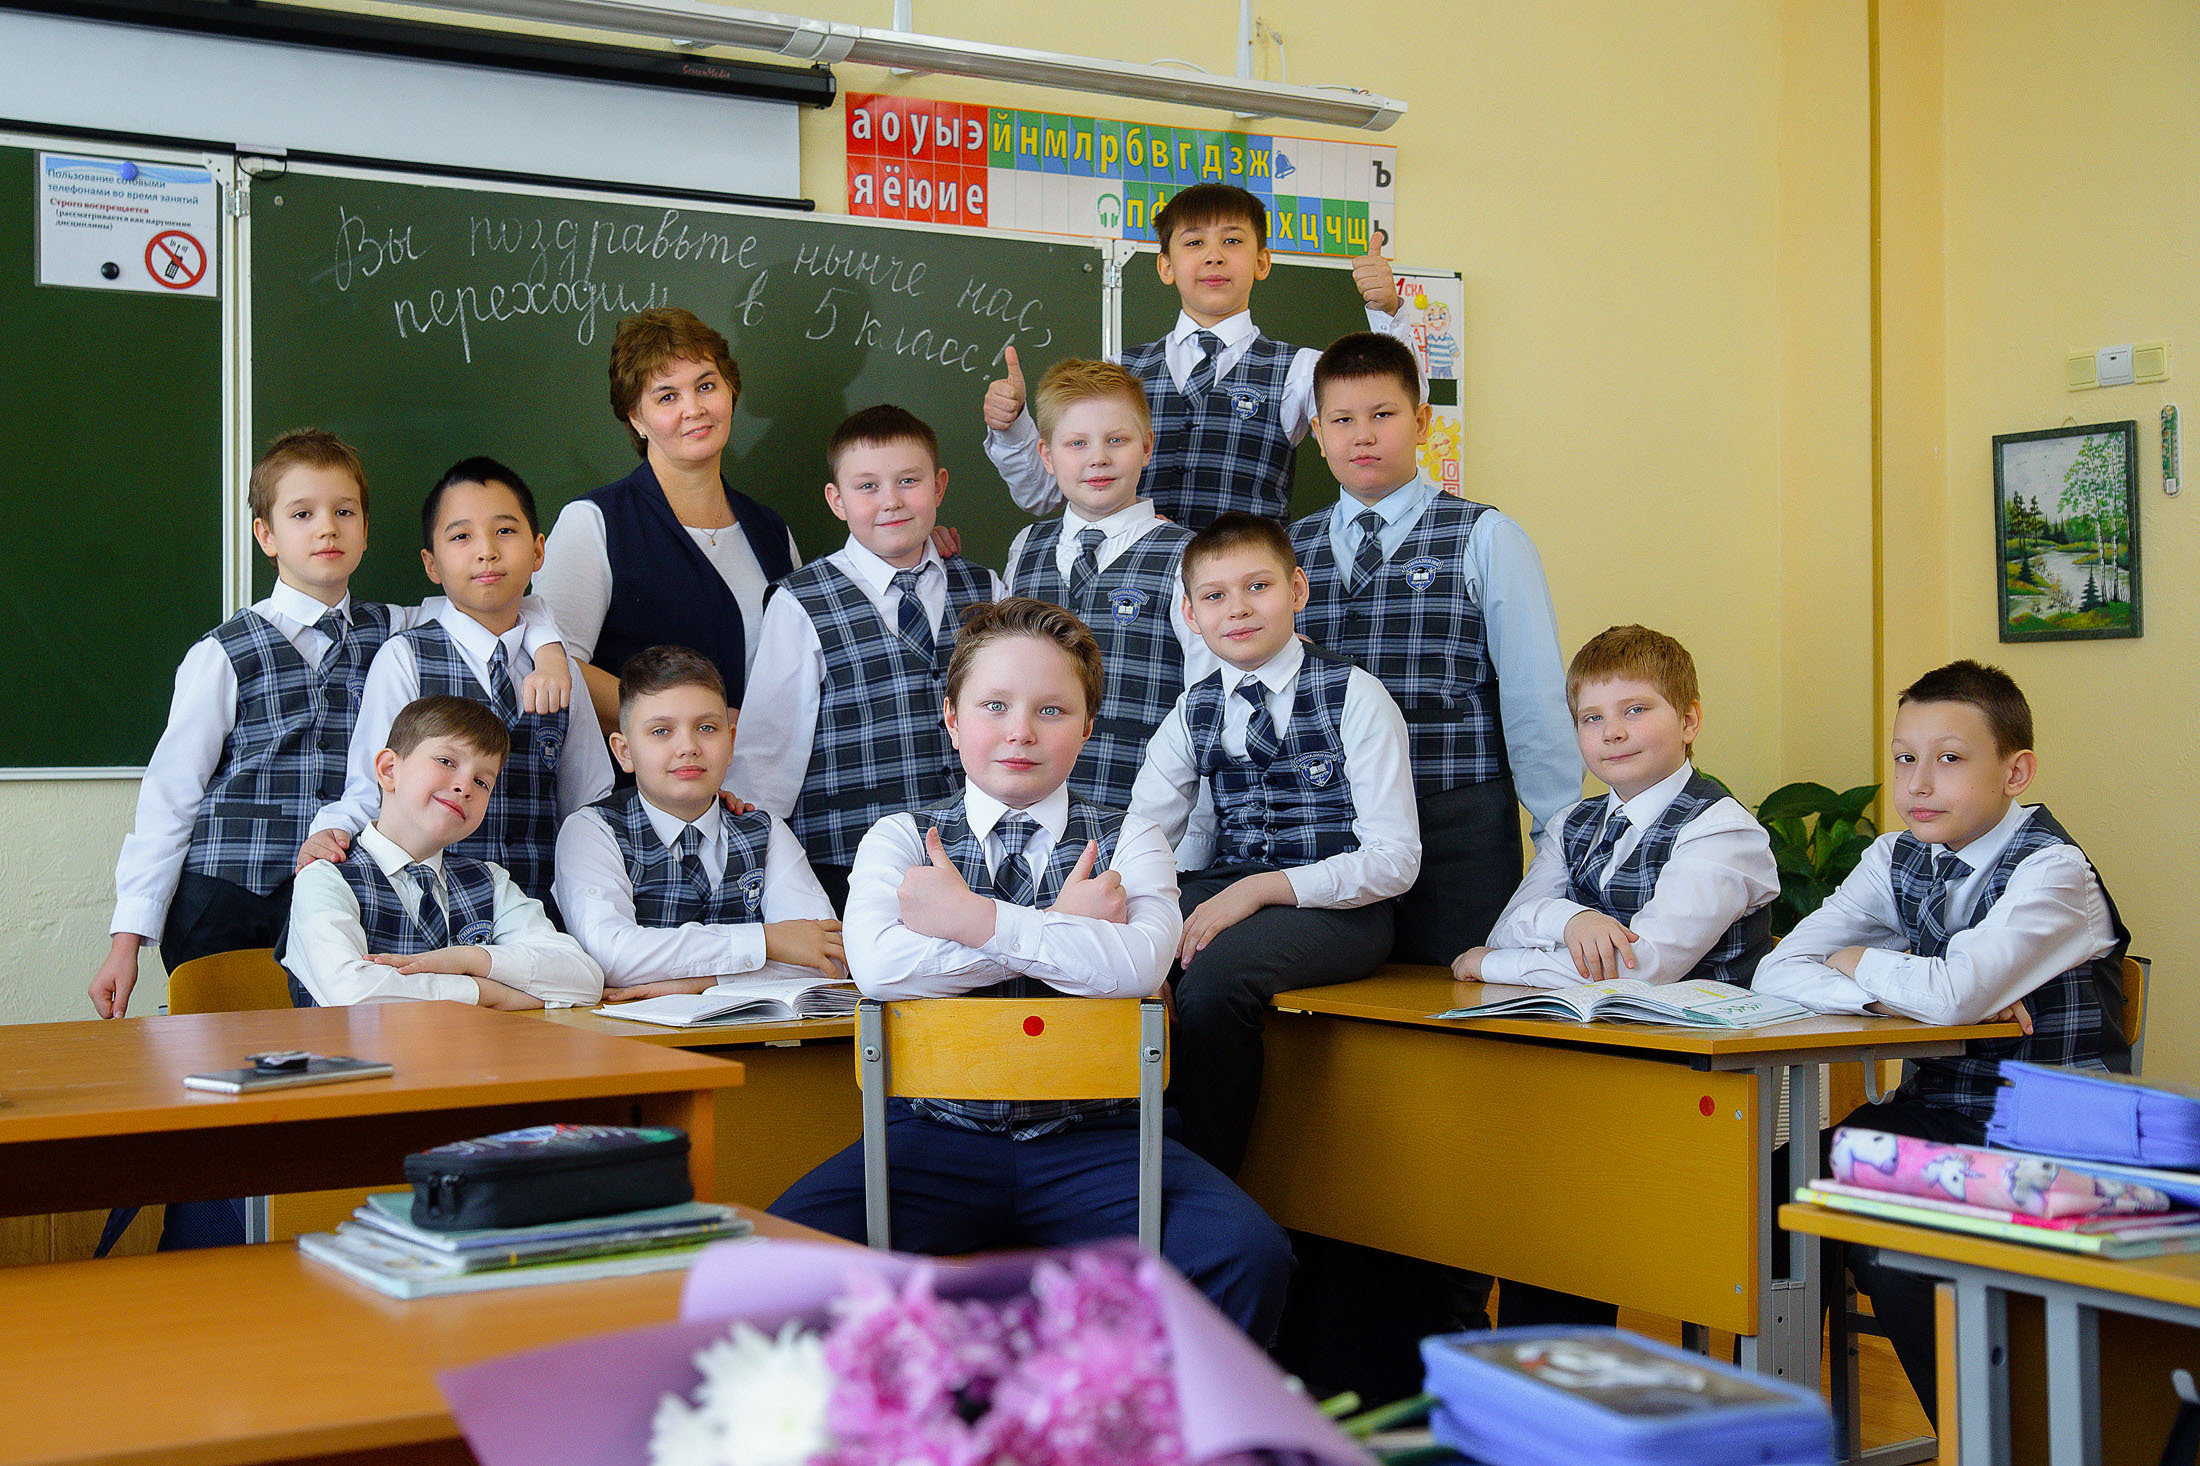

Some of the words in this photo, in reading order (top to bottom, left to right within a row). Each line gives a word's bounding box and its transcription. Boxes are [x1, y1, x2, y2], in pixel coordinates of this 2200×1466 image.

[48, 168, 114, 184] Пользование
[48, 183, 110, 196] телефонами
[112, 190, 125, 198] во
[127, 191, 158, 201] время
[160, 194, 199, 205] занятий
[50, 197, 83, 208] Строго
[84, 202, 149, 214] воспрещается
[335, 205, 428, 291] Вы
[471, 209, 758, 281] поздравьте
[794, 242, 927, 297] нынче
[735, 269, 769, 326] в
[805, 287, 859, 341] 5
